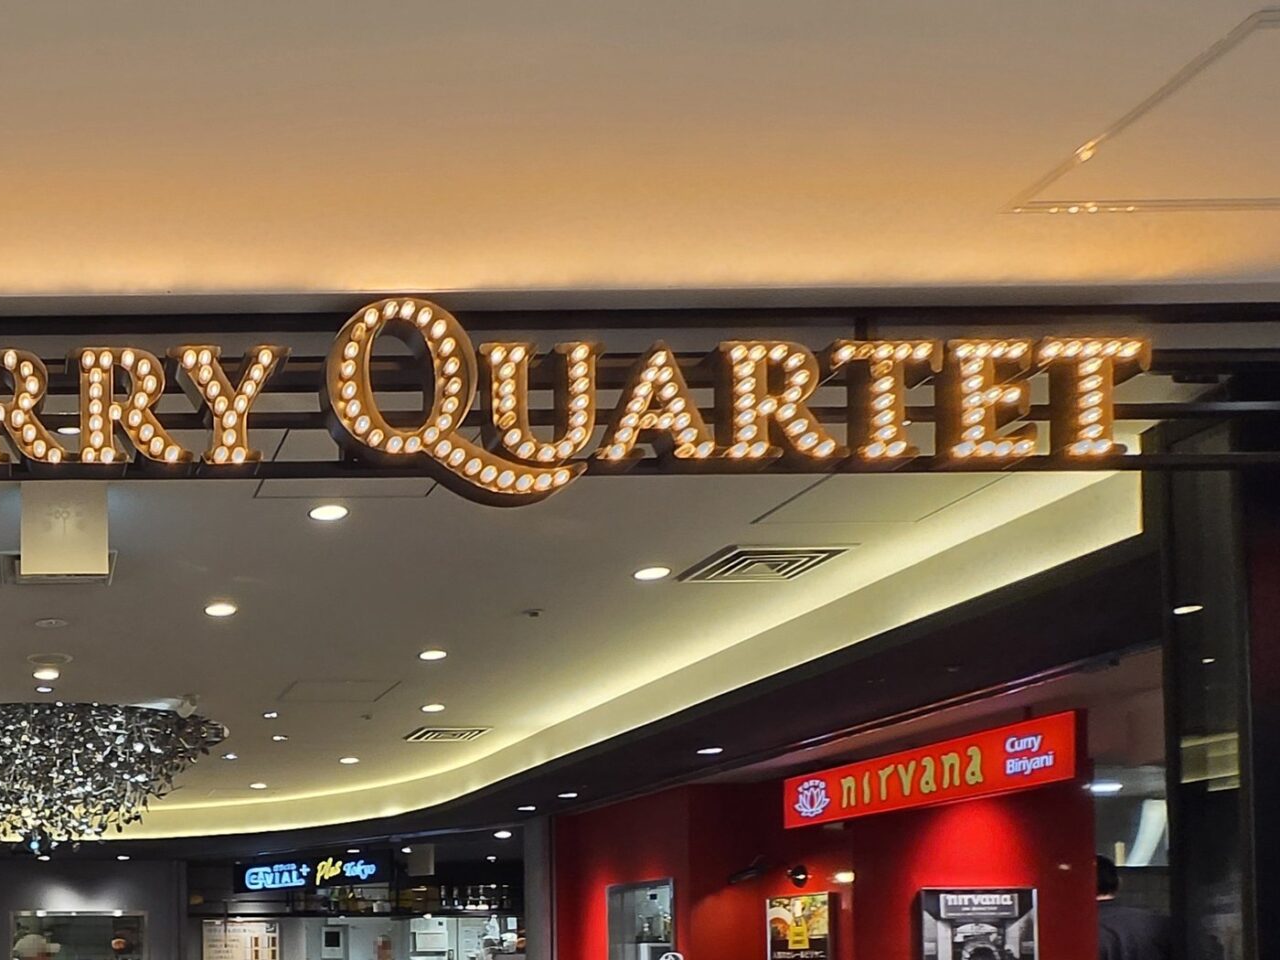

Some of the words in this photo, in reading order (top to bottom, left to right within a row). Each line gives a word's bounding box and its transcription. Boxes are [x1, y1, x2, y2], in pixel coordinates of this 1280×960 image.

[327, 297, 1152, 502] QUARTET
[1005, 735, 1042, 753] Curry
[841, 746, 983, 808] nirvana
